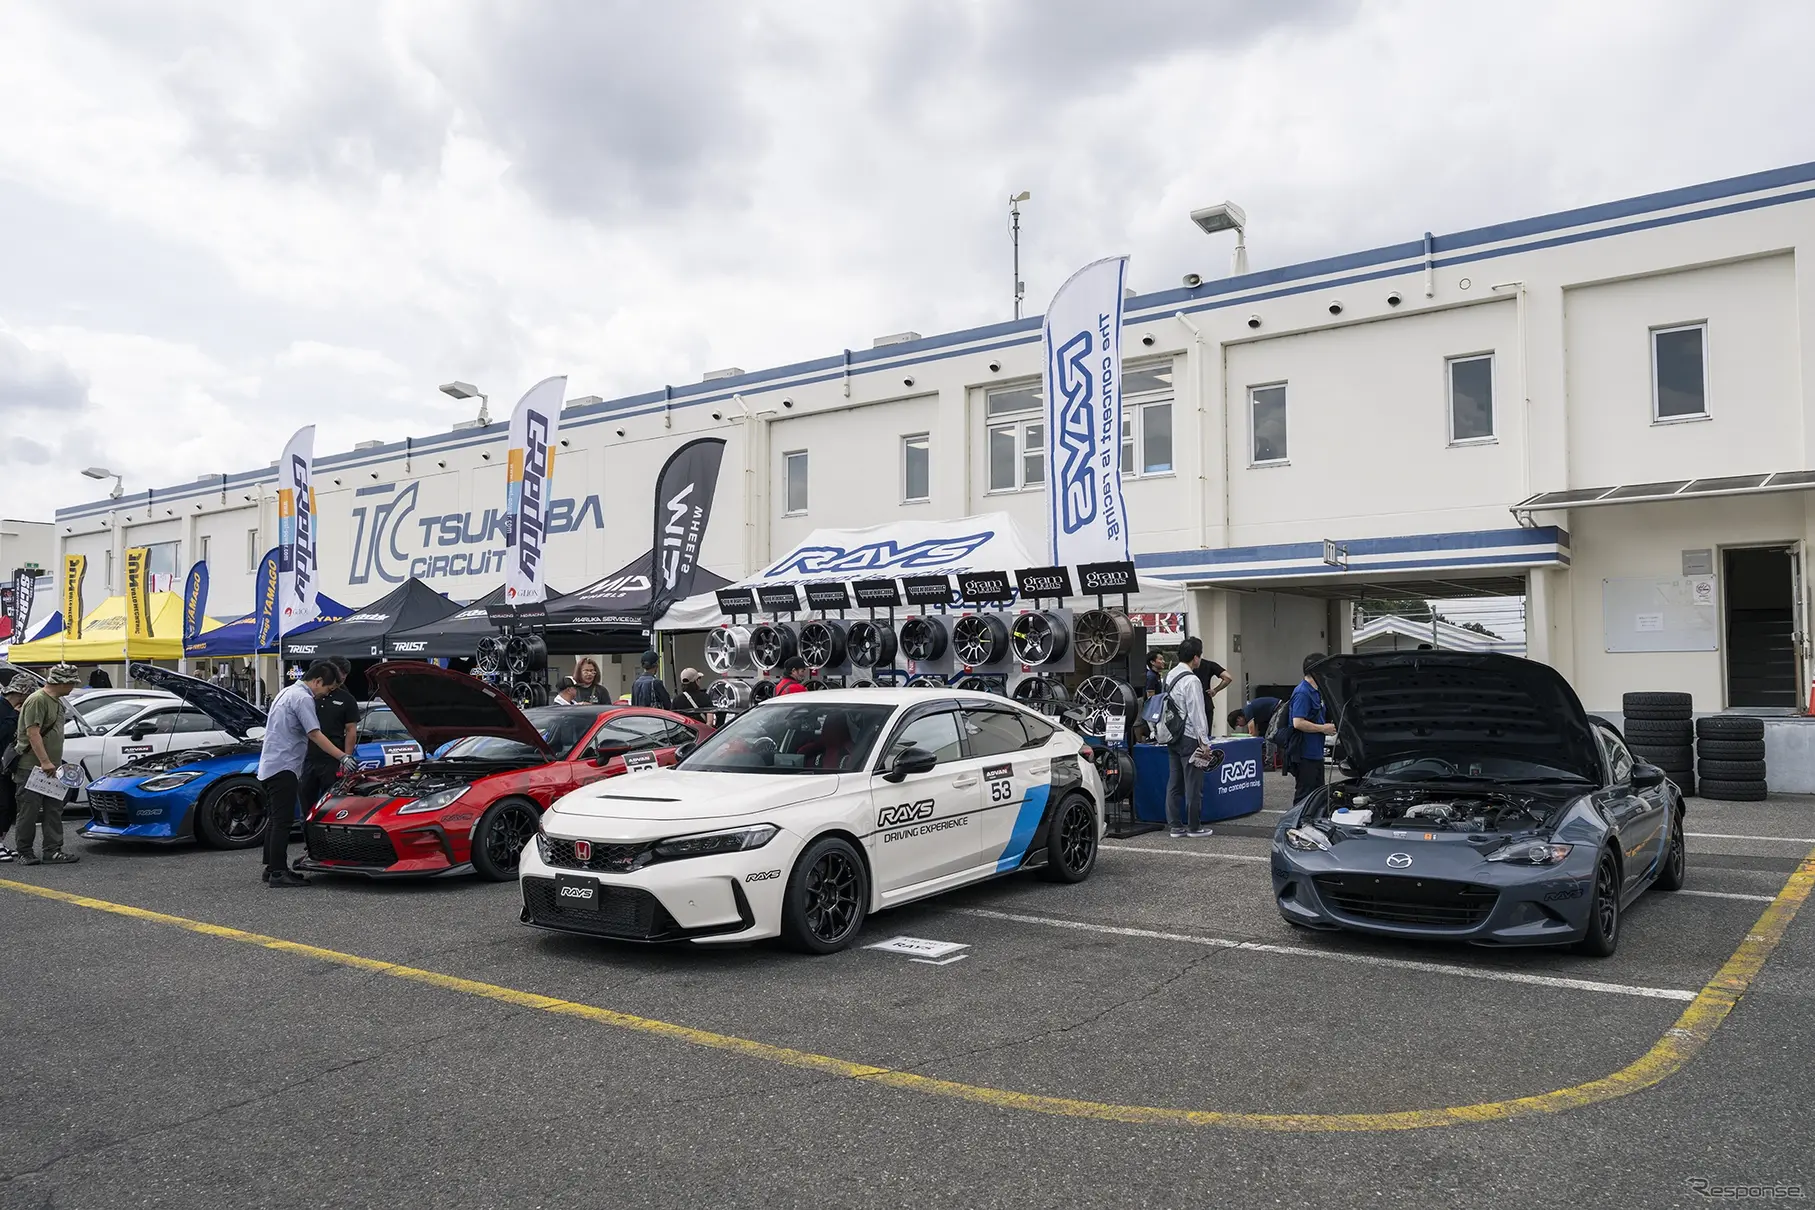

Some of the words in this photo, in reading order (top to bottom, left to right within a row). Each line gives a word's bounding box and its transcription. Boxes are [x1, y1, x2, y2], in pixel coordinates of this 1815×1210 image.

[418, 494, 605, 548] TSUKBA
[764, 531, 996, 578] RAYS
[264, 559, 278, 616] YAMAGO
[965, 579, 1003, 596] gram
[1023, 575, 1063, 592] gram
[1086, 571, 1129, 588] gram
[187, 572, 202, 625] YAMAGO
[579, 592, 627, 600] WHEELS
[287, 644, 319, 654] TRUST
[392, 641, 428, 652] TRUST
[986, 768, 1009, 777] ADVAN
[1220, 759, 1256, 784] RAYS
[991, 780, 1012, 802] 53
[877, 798, 935, 828] RAYS
[884, 826, 919, 844] DRIVING
[919, 816, 969, 836] EXPERIENCE
[745, 869, 781, 883] RAYS
[560, 885, 594, 899] RAYS
[1543, 888, 1584, 902] RAYS
